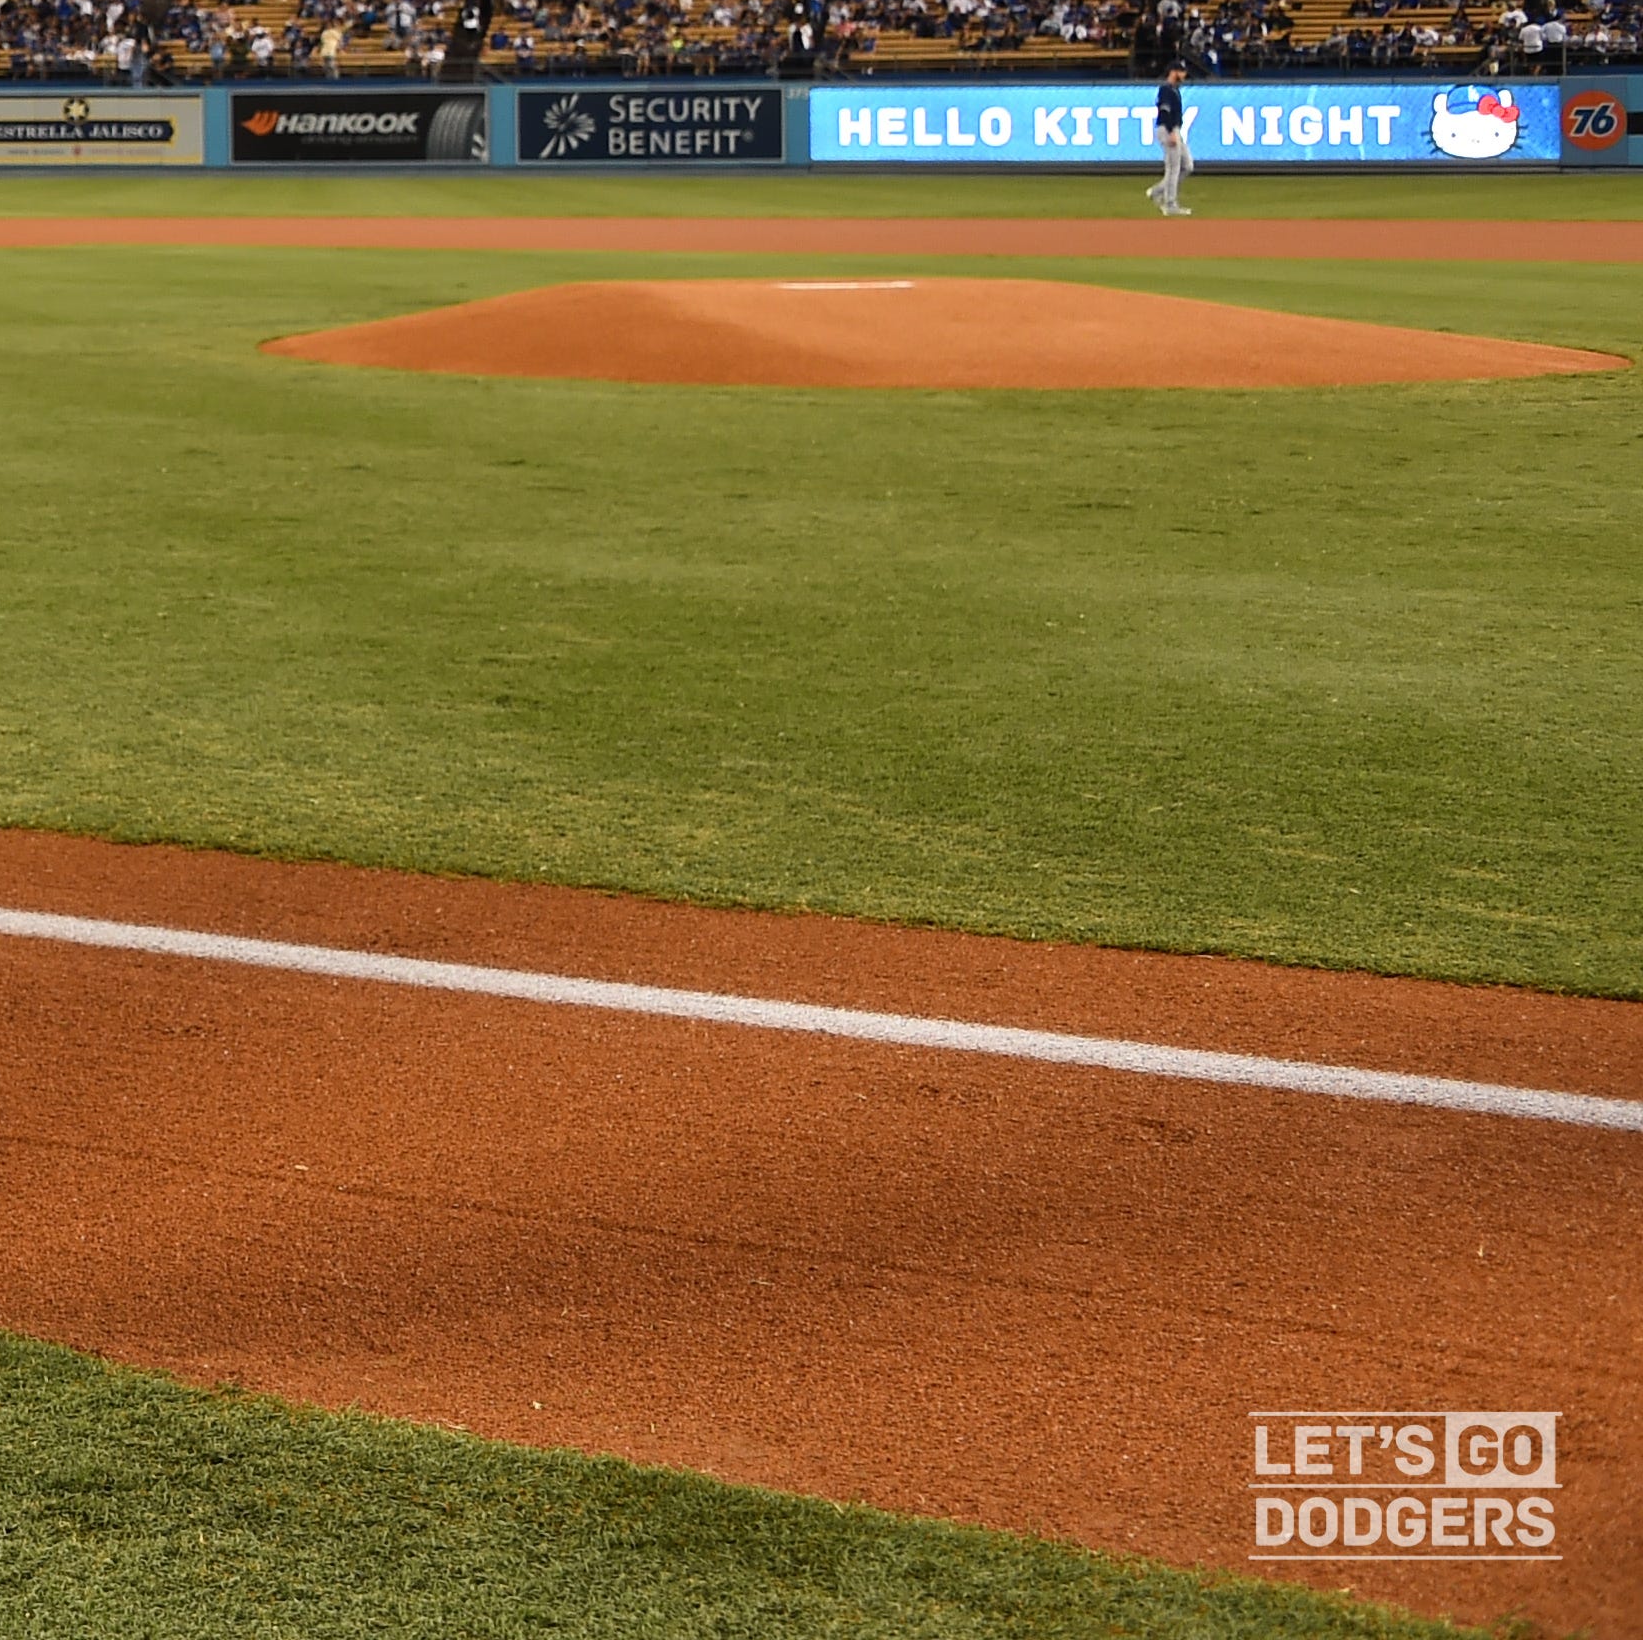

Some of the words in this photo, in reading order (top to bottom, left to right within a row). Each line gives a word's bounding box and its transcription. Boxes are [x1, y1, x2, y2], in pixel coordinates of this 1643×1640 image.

[609, 95, 762, 123] SECURITY
[1571, 102, 1618, 137] 76
[88, 124, 164, 141] JALISCO
[837, 107, 1012, 147] HELLO
[1221, 105, 1401, 145] NIGHT
